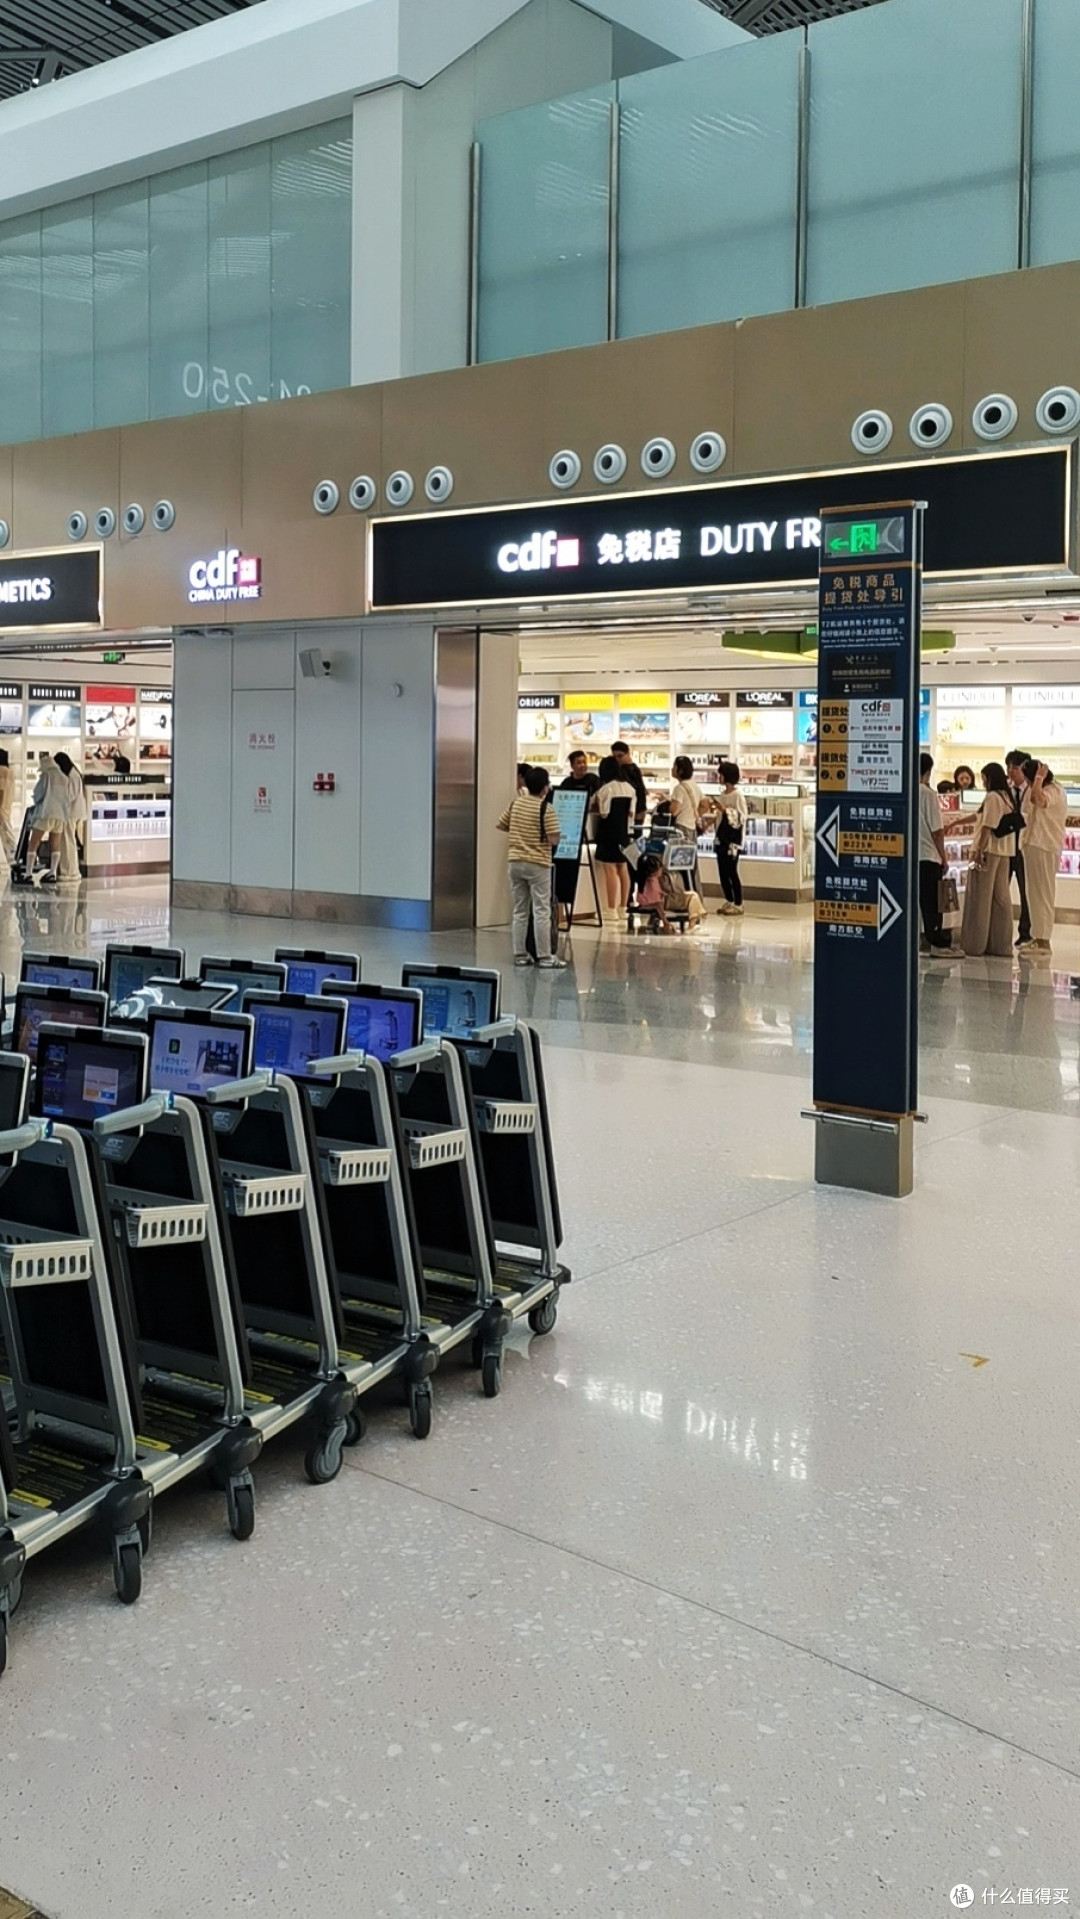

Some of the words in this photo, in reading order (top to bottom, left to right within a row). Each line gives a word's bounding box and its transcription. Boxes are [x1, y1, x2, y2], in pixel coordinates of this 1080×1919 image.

[597, 528, 682, 566] 免税店
[700, 521, 778, 557] DUTY
[498, 531, 557, 573] cdf
[189, 549, 239, 589] cdf
[832, 573, 895, 590] 免税商品
[188, 588, 215, 603] CHINA
[216, 587, 238, 601] DUTY
[238, 585, 260, 598] FREE
[824, 587, 903, 605] 提货处导引
[519, 697, 555, 707] ORIGINS
[861, 700, 882, 712] cdf
[829, 924, 863, 934] 南方航空
